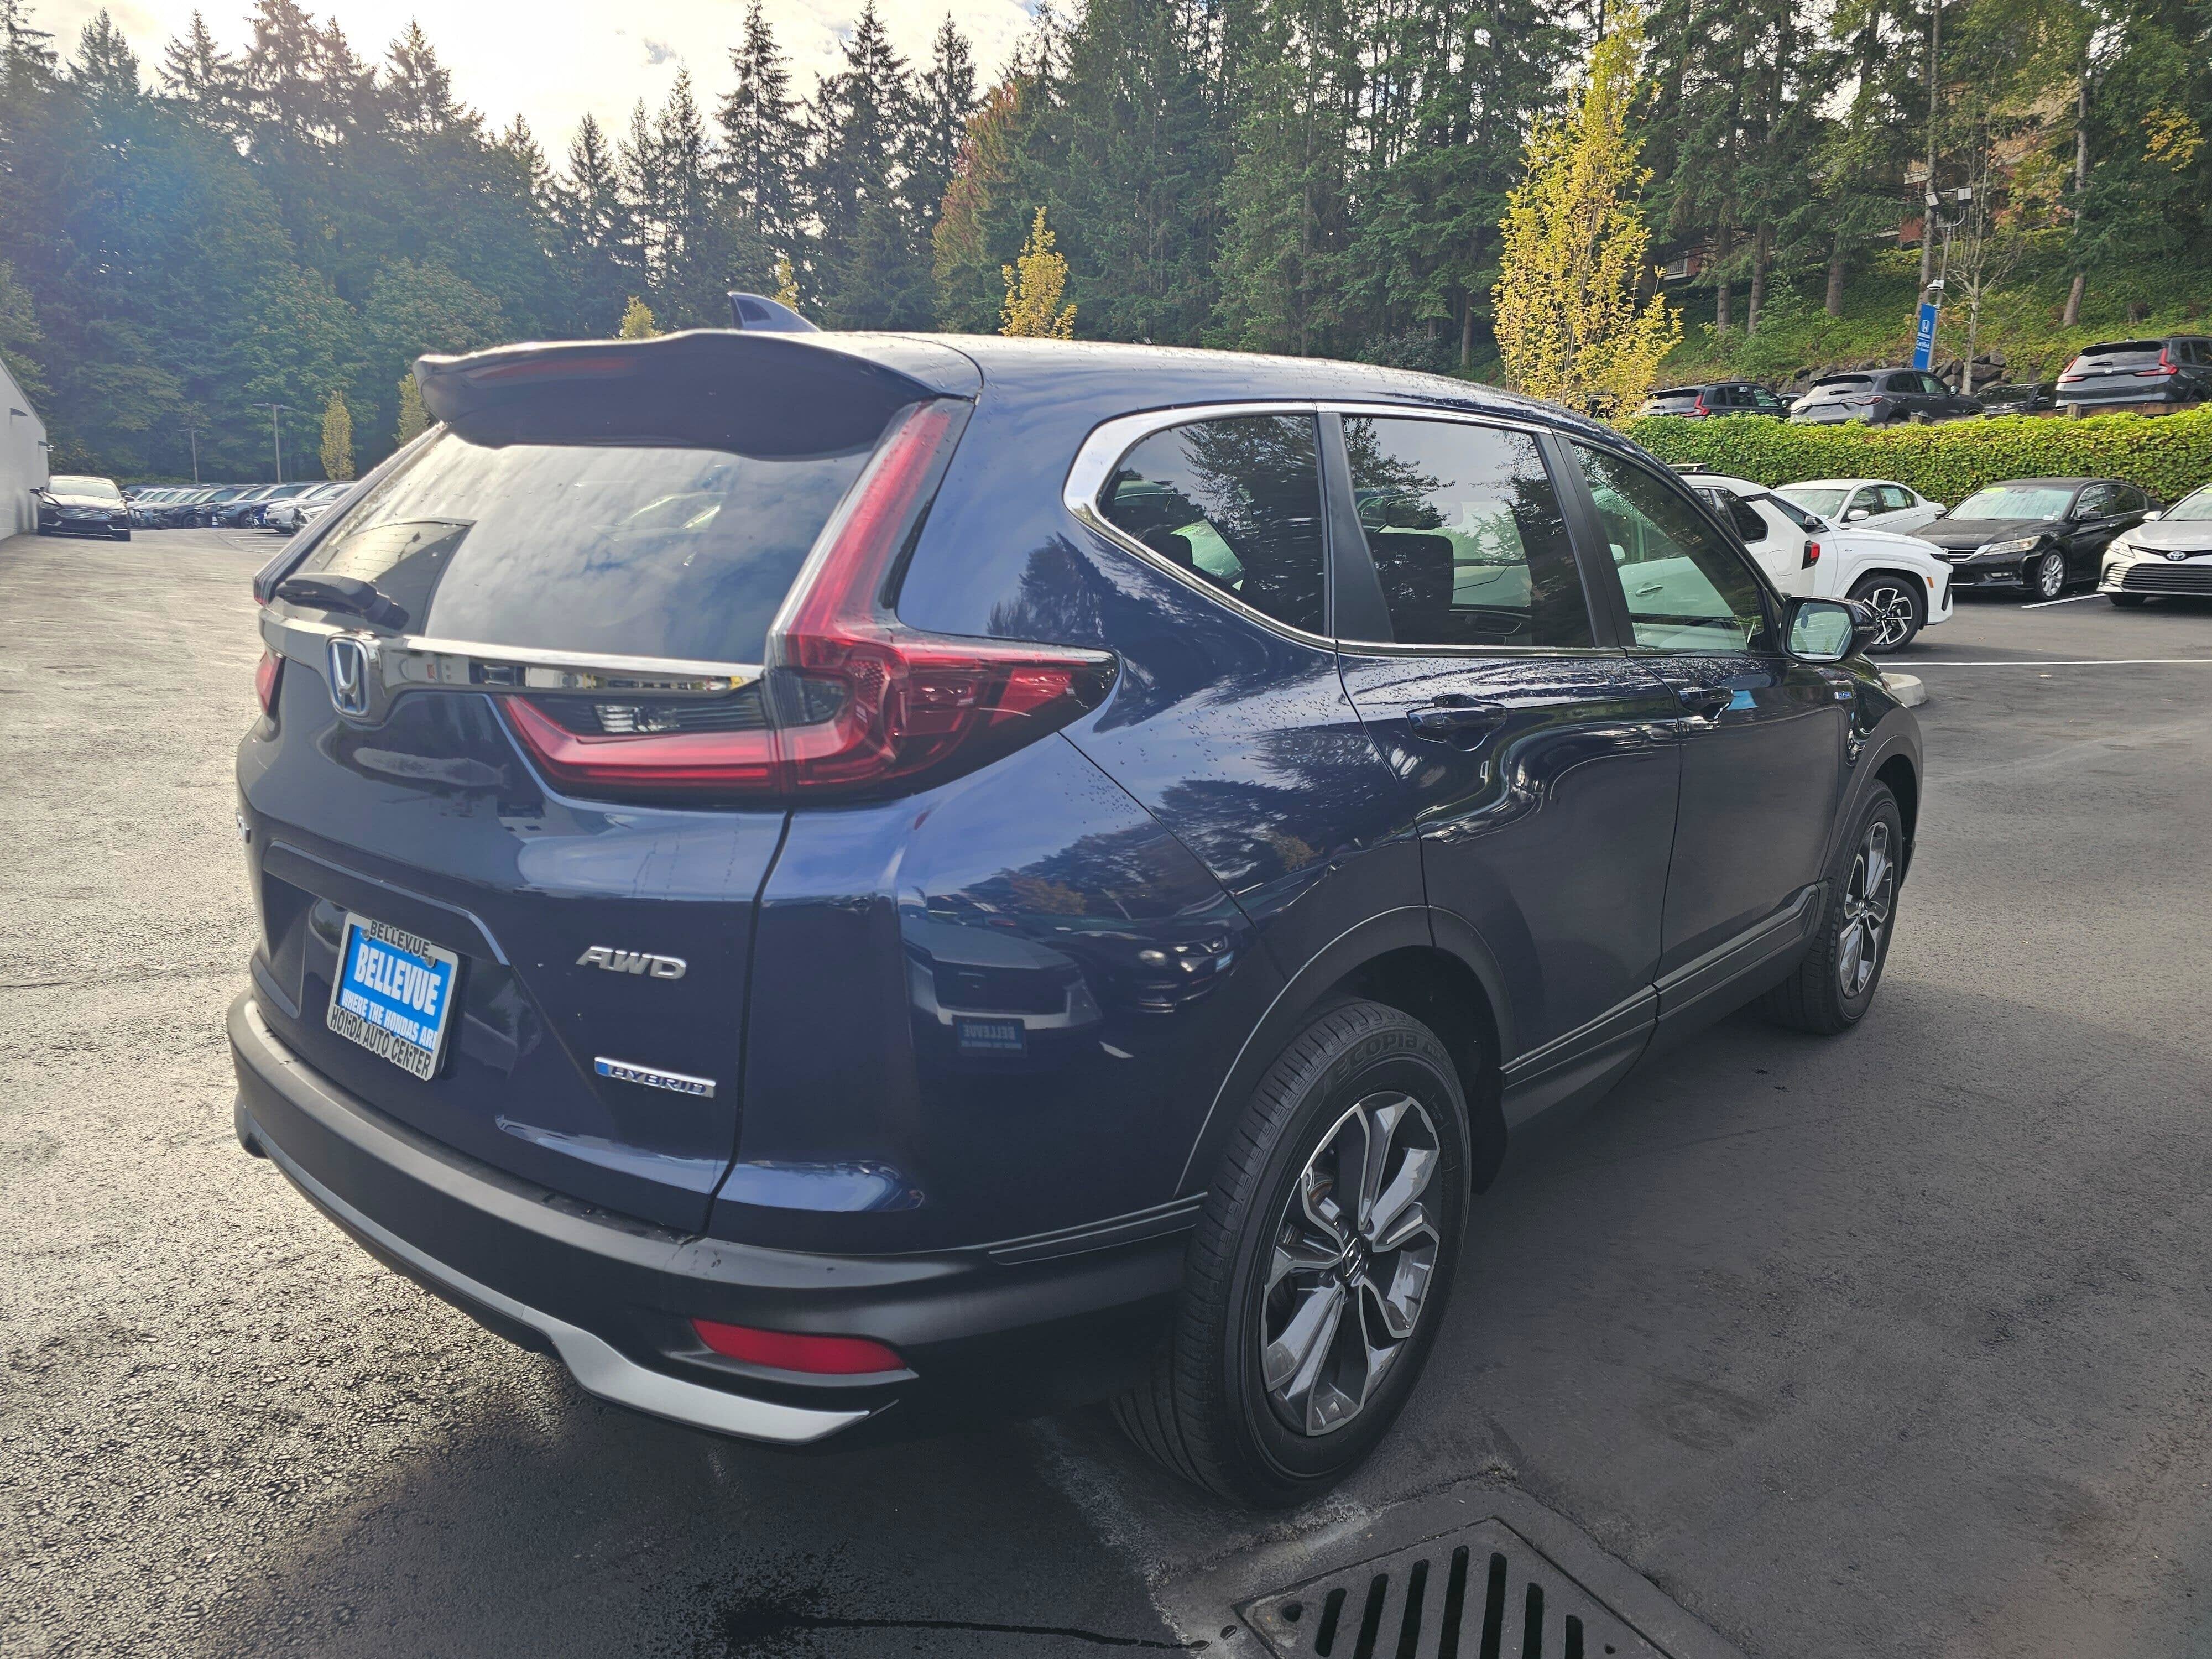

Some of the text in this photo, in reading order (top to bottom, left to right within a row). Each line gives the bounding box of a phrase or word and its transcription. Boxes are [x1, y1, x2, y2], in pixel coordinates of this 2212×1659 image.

[370, 921, 431, 958] BELLEVUE
[576, 945, 687, 979] AWD
[354, 943, 441, 1016] BELLEVUE
[341, 988, 368, 1017] WHERE
[368, 1001, 384, 1023] THE
[384, 1009, 420, 1042] HONDAS
[330, 1006, 431, 1078] HONDA AUTO CENTER
[612, 1066, 707, 1095] HYBRID
